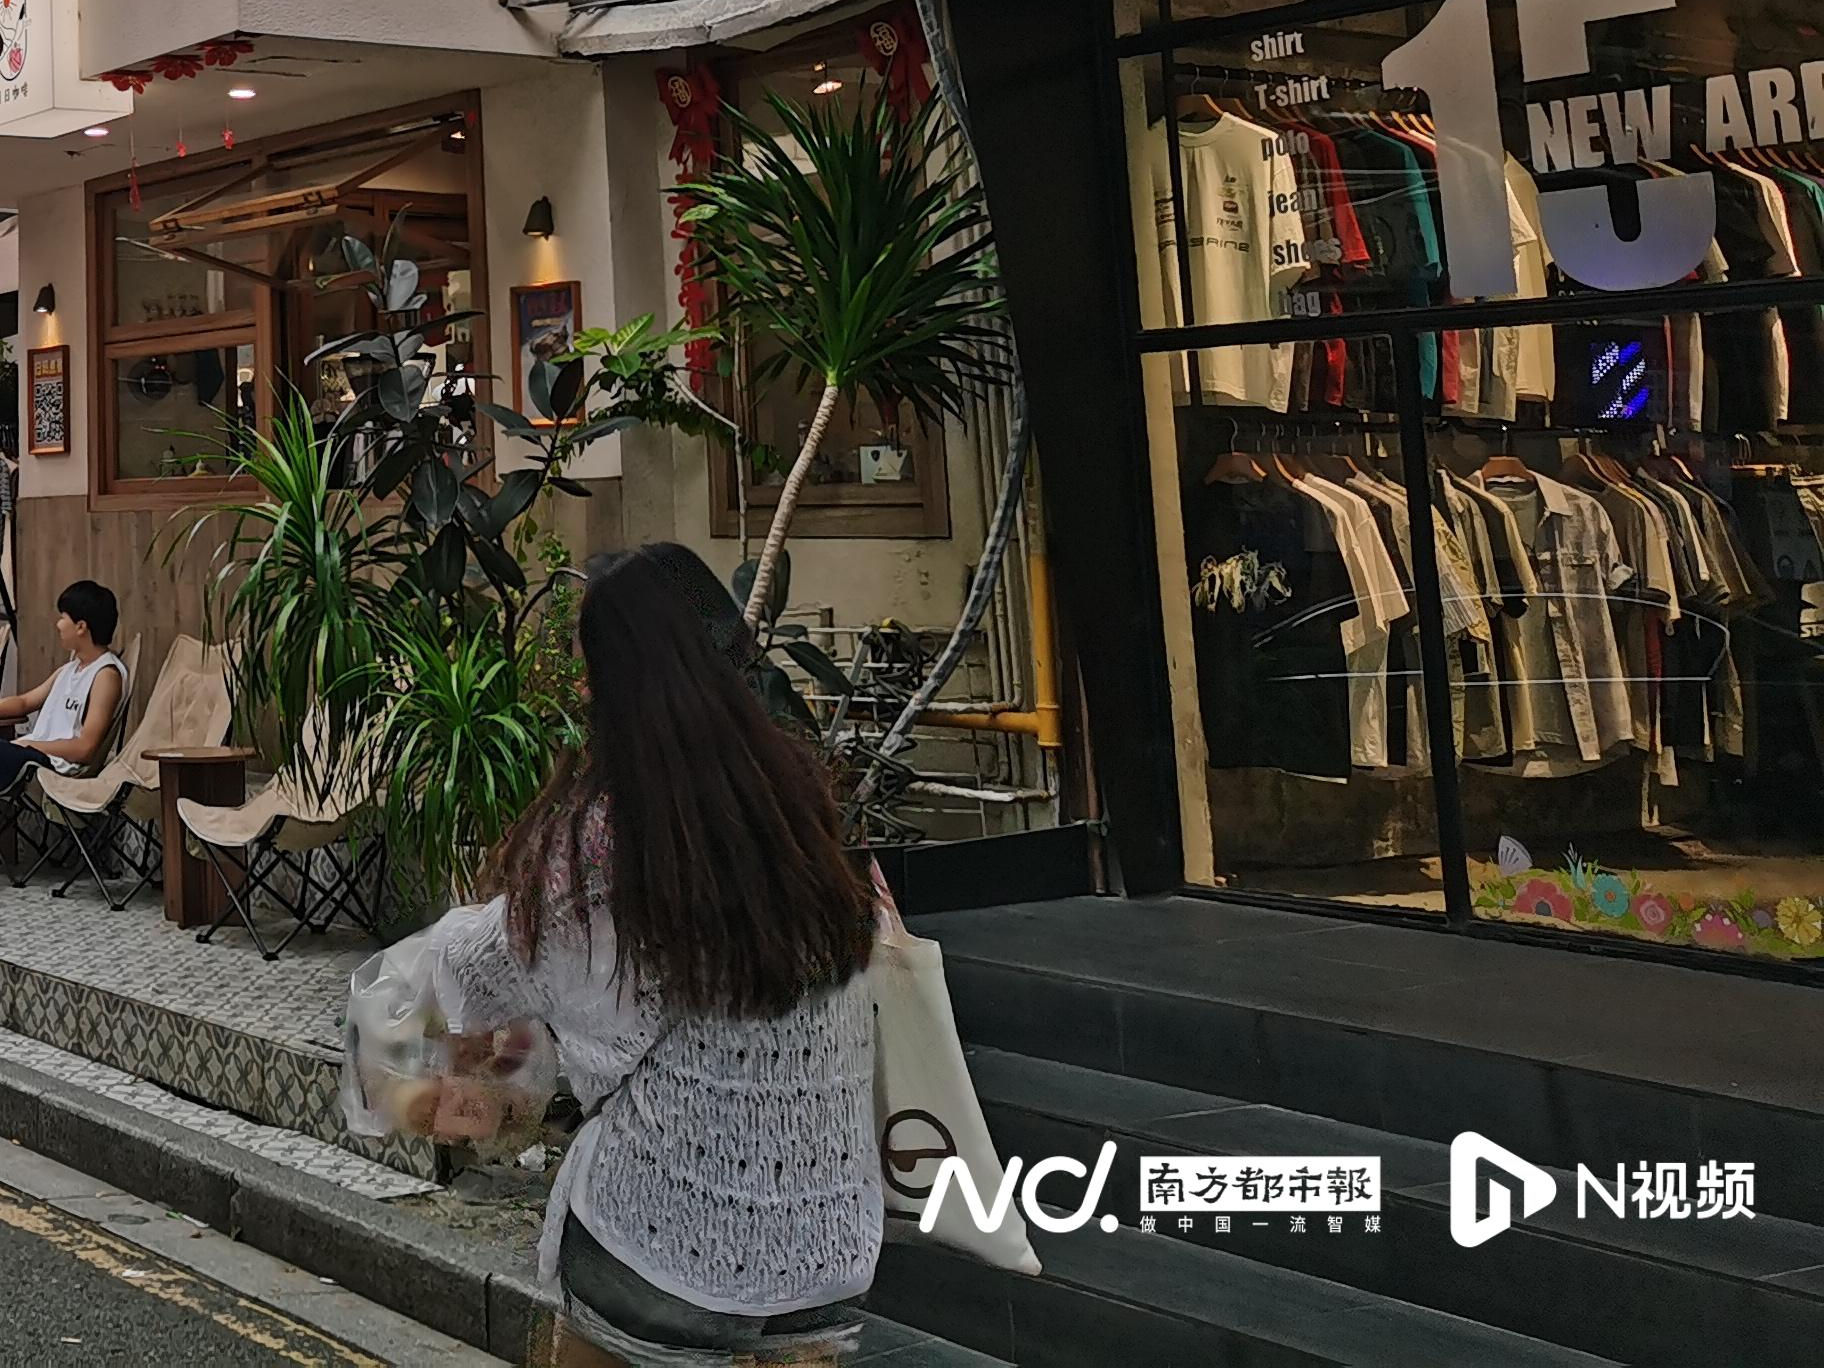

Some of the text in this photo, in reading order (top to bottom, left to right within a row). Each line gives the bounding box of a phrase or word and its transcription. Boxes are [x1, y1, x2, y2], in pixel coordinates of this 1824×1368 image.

[1250, 31, 1305, 62] shirt
[1254, 75, 1331, 110] T-shirt
[1260, 129, 1310, 161] polo
[1526, 85, 1671, 173] NEW
